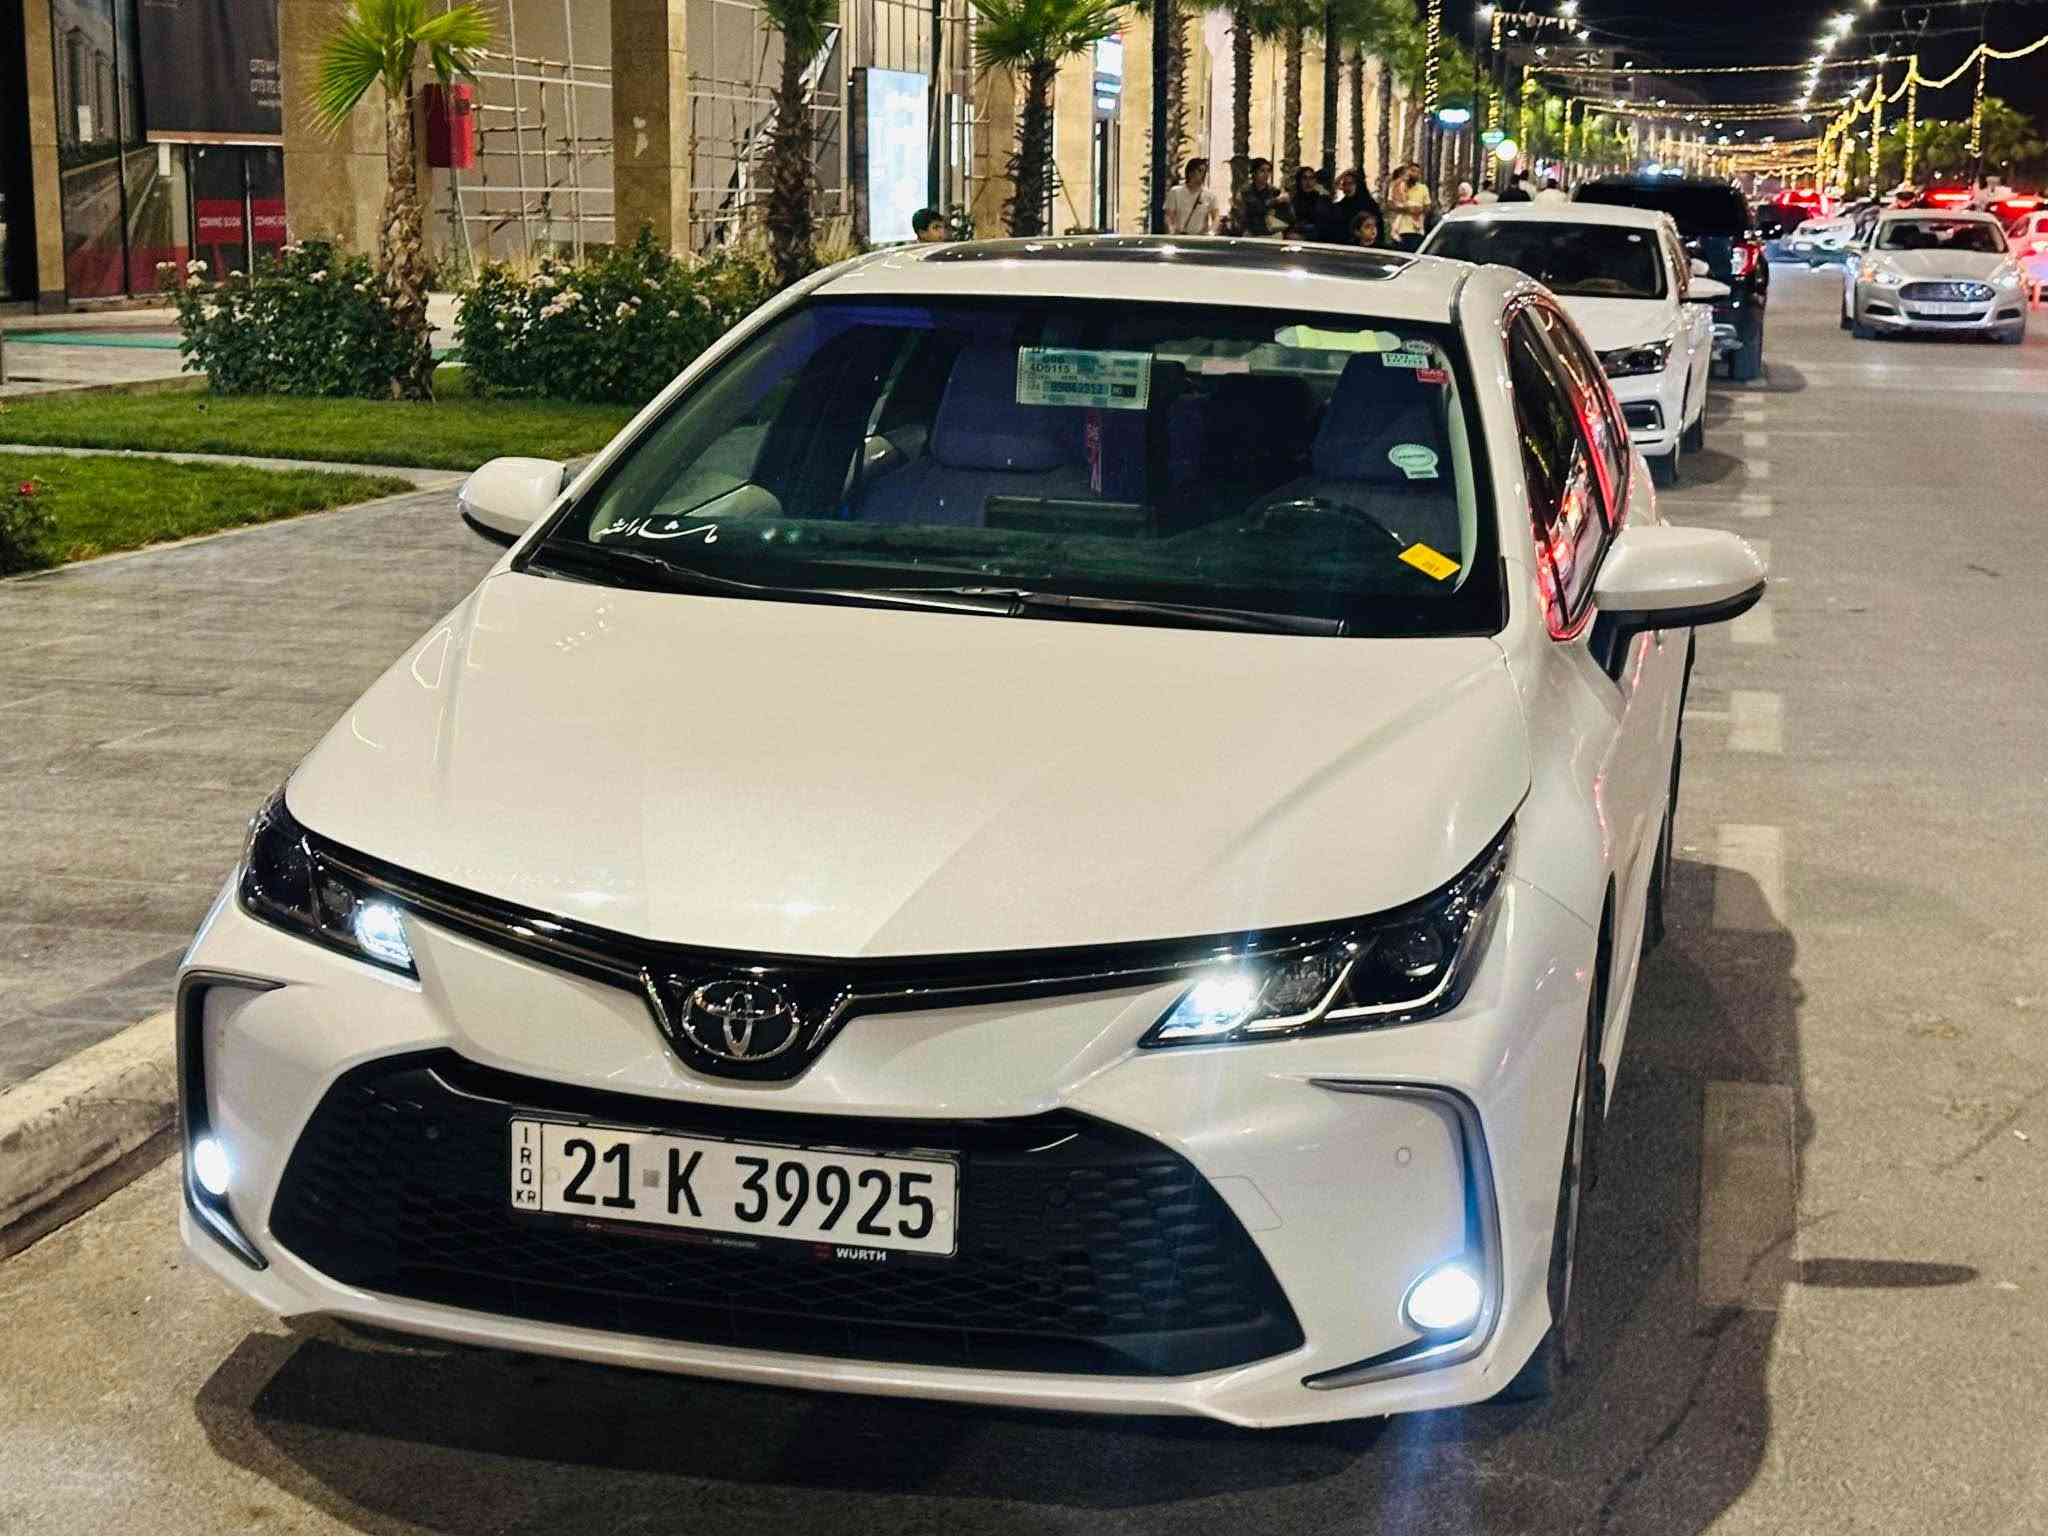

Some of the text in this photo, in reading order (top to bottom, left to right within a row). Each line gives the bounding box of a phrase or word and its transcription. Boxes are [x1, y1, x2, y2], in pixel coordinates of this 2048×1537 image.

[563, 1138, 934, 1239] 21 K 39925
